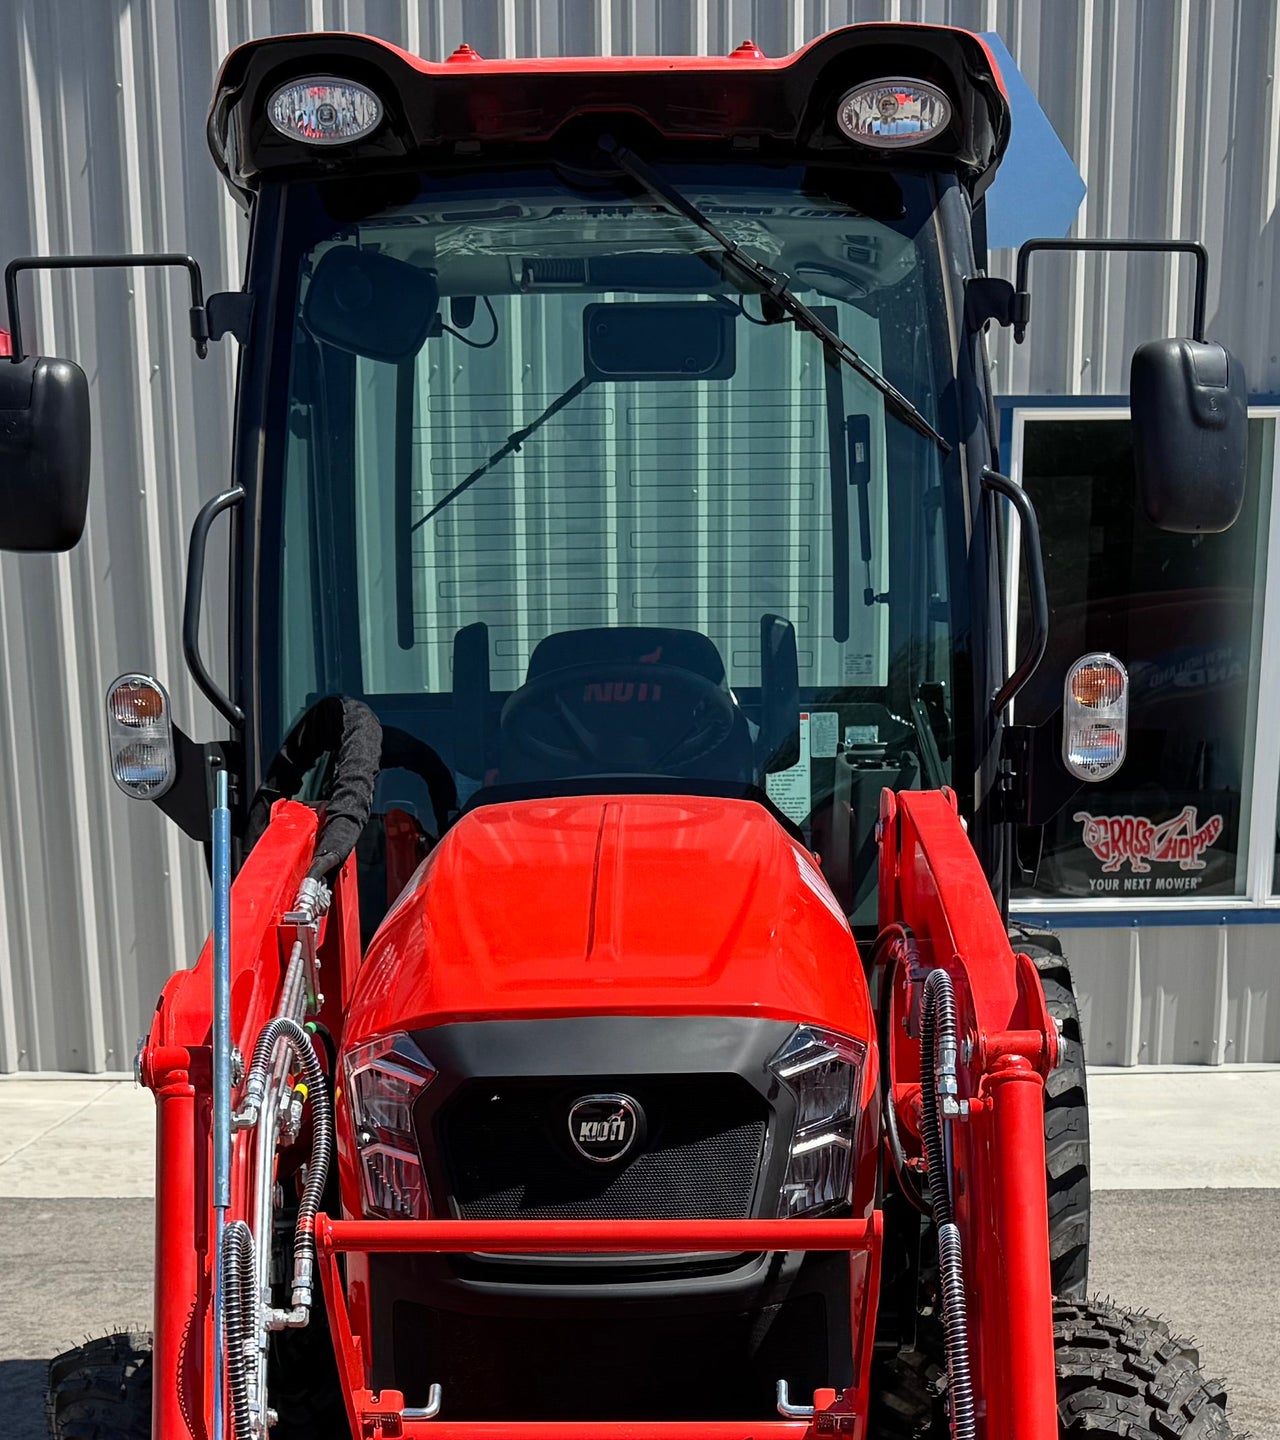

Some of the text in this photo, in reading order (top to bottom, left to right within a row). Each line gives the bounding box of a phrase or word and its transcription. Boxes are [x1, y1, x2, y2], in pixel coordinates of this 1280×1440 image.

[1089, 878, 1119, 891] YOUR
[1124, 878, 1151, 890] NEXT
[579, 1120, 626, 1142] KIOTI
